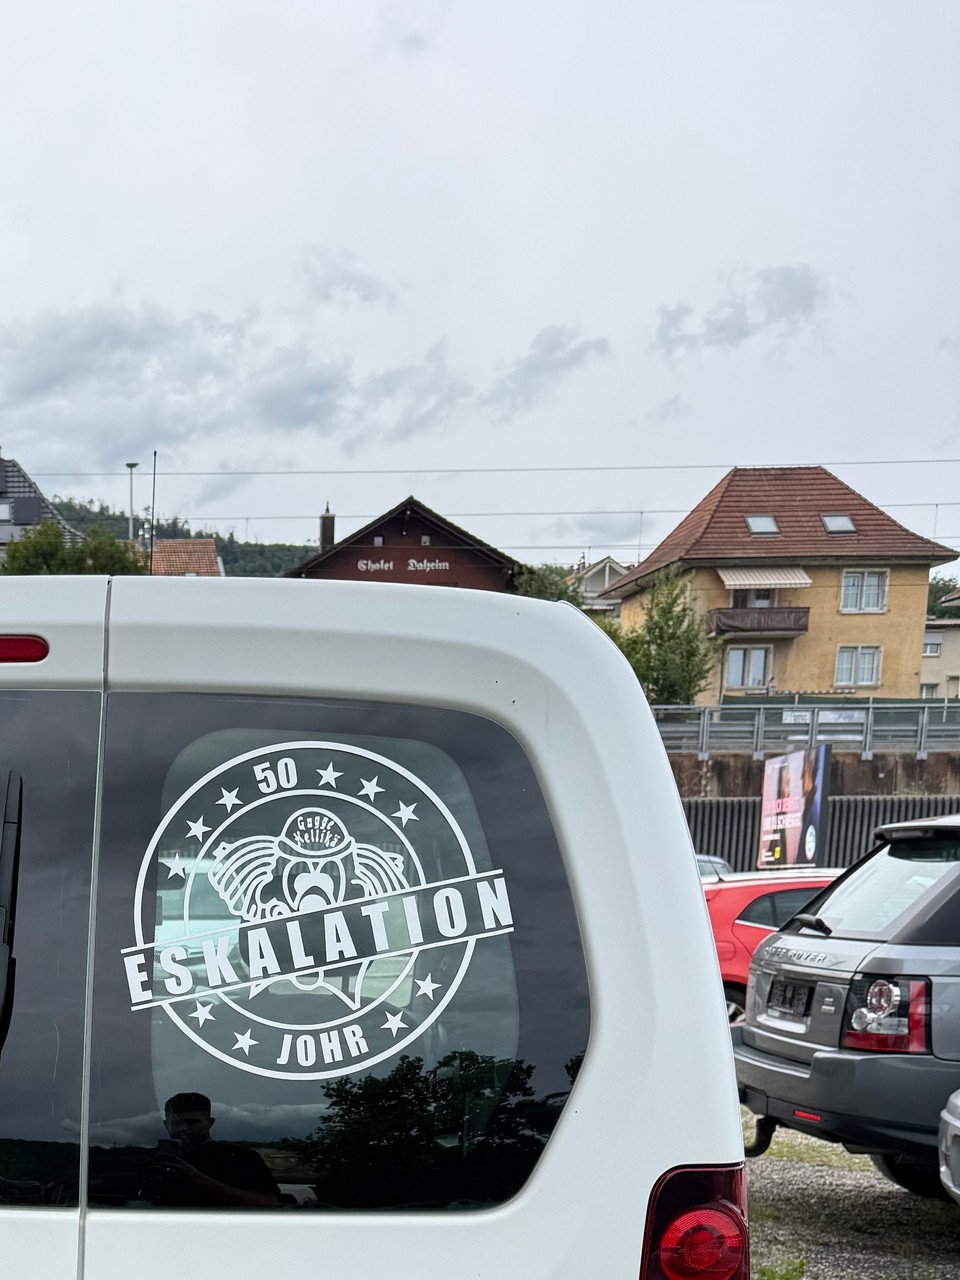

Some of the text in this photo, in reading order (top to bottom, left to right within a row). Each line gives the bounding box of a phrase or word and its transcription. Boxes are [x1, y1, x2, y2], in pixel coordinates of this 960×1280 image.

[357, 558, 449, 573] Chalet Daheim
[253, 757, 299, 794] 50
[123, 877, 513, 1004] ESKALATION
[276, 1023, 369, 1067] JOHR
